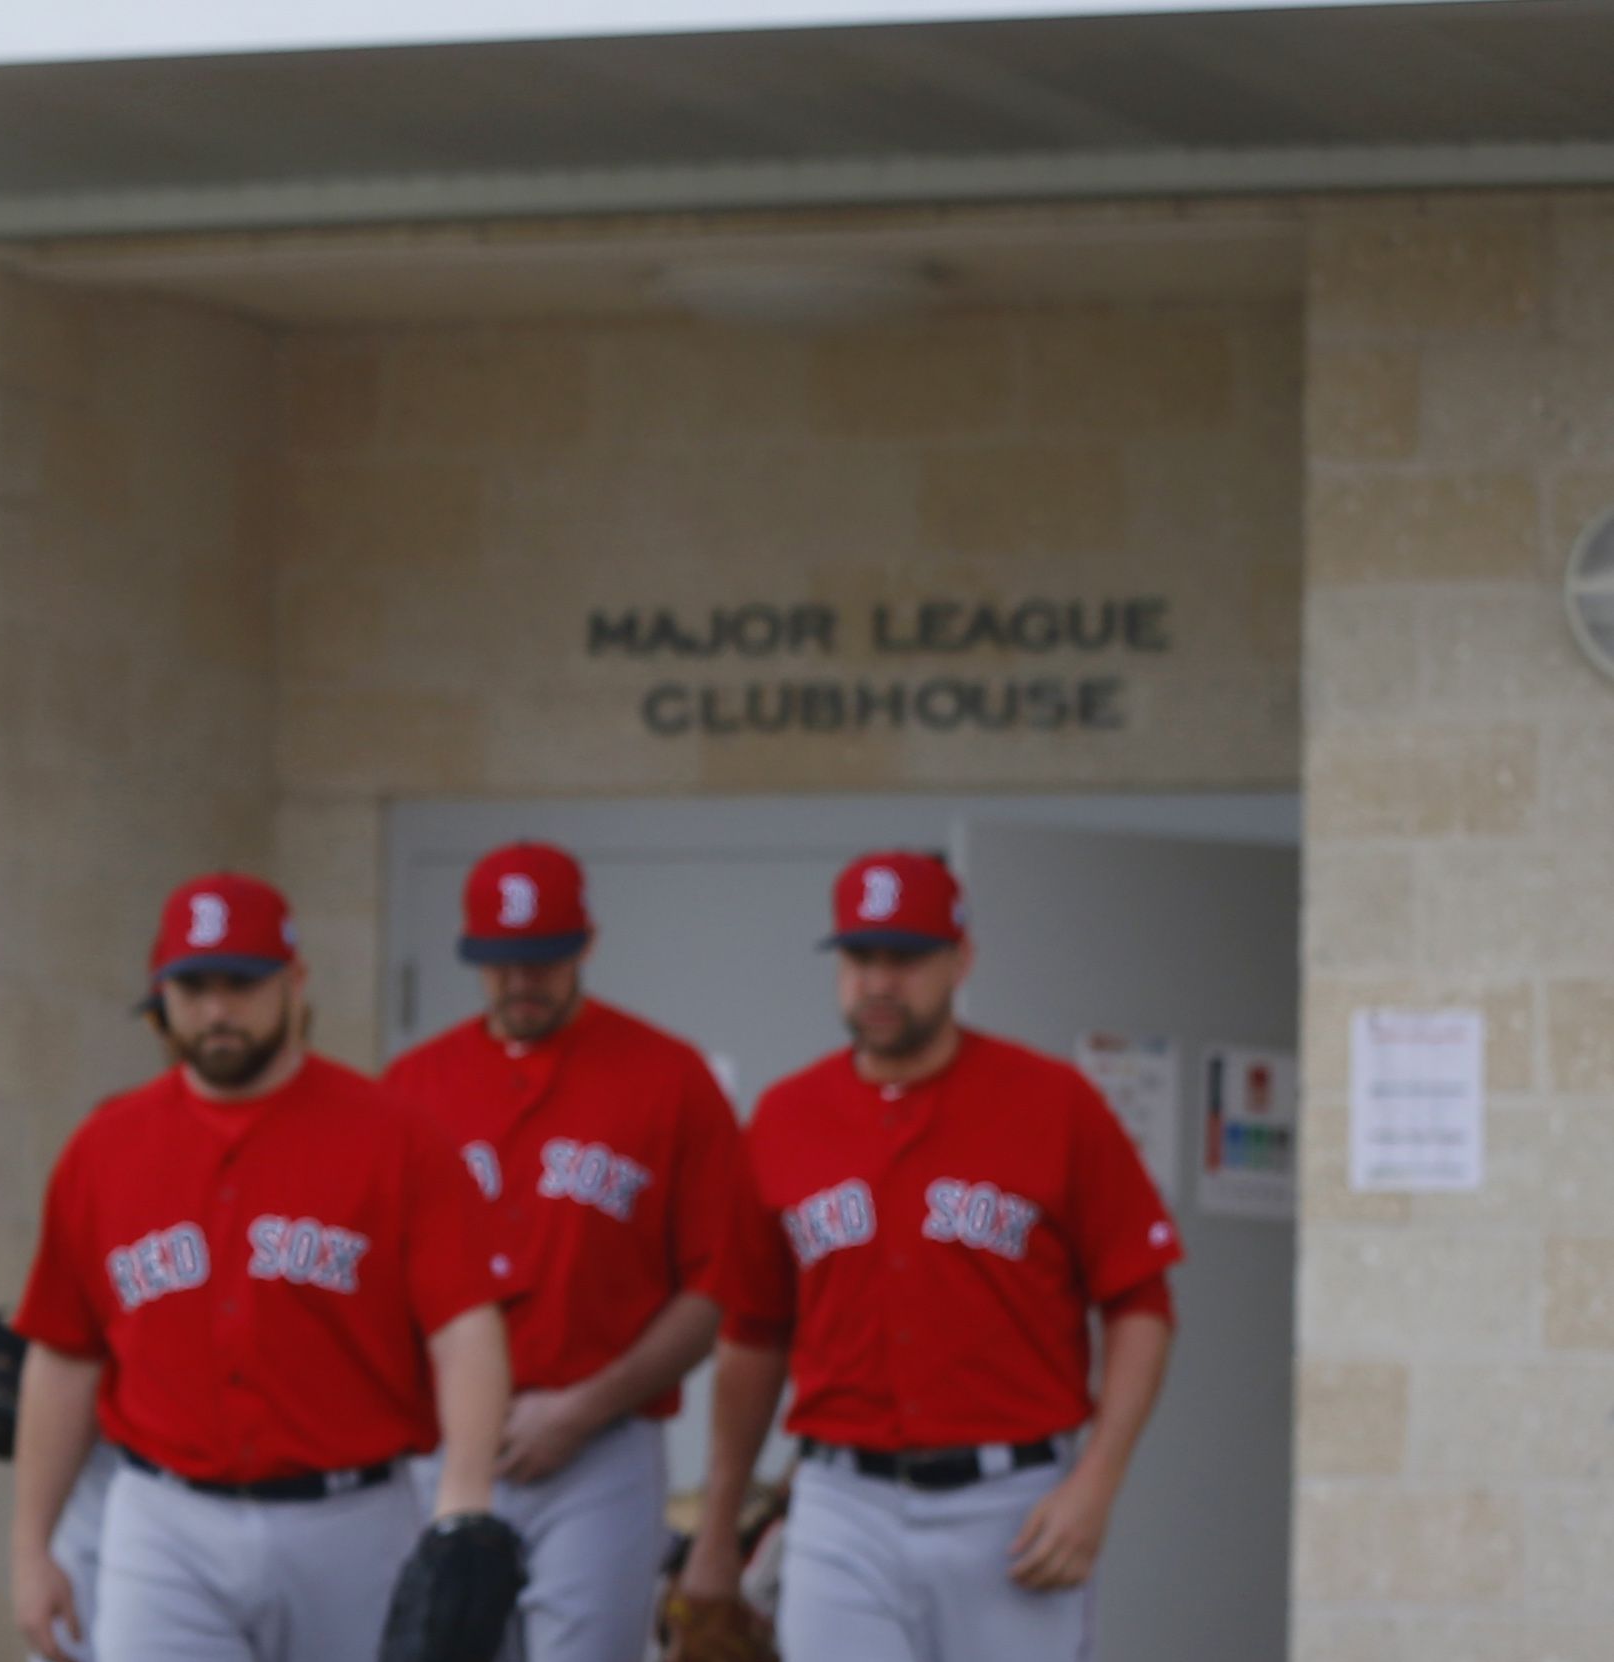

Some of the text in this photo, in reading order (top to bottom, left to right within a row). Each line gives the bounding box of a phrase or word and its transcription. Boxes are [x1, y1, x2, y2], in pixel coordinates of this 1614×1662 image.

[586, 596, 1170, 660] MAJOR LEAGUE
[640, 675, 1129, 738] CLUBHOUSE
[187, 892, 229, 947] B
[497, 873, 539, 928] B
[858, 866, 903, 922] B
[537, 1137, 653, 1223] SOX
[922, 1175, 1040, 1261] SOX
[106, 1214, 371, 1311] RED SOX
